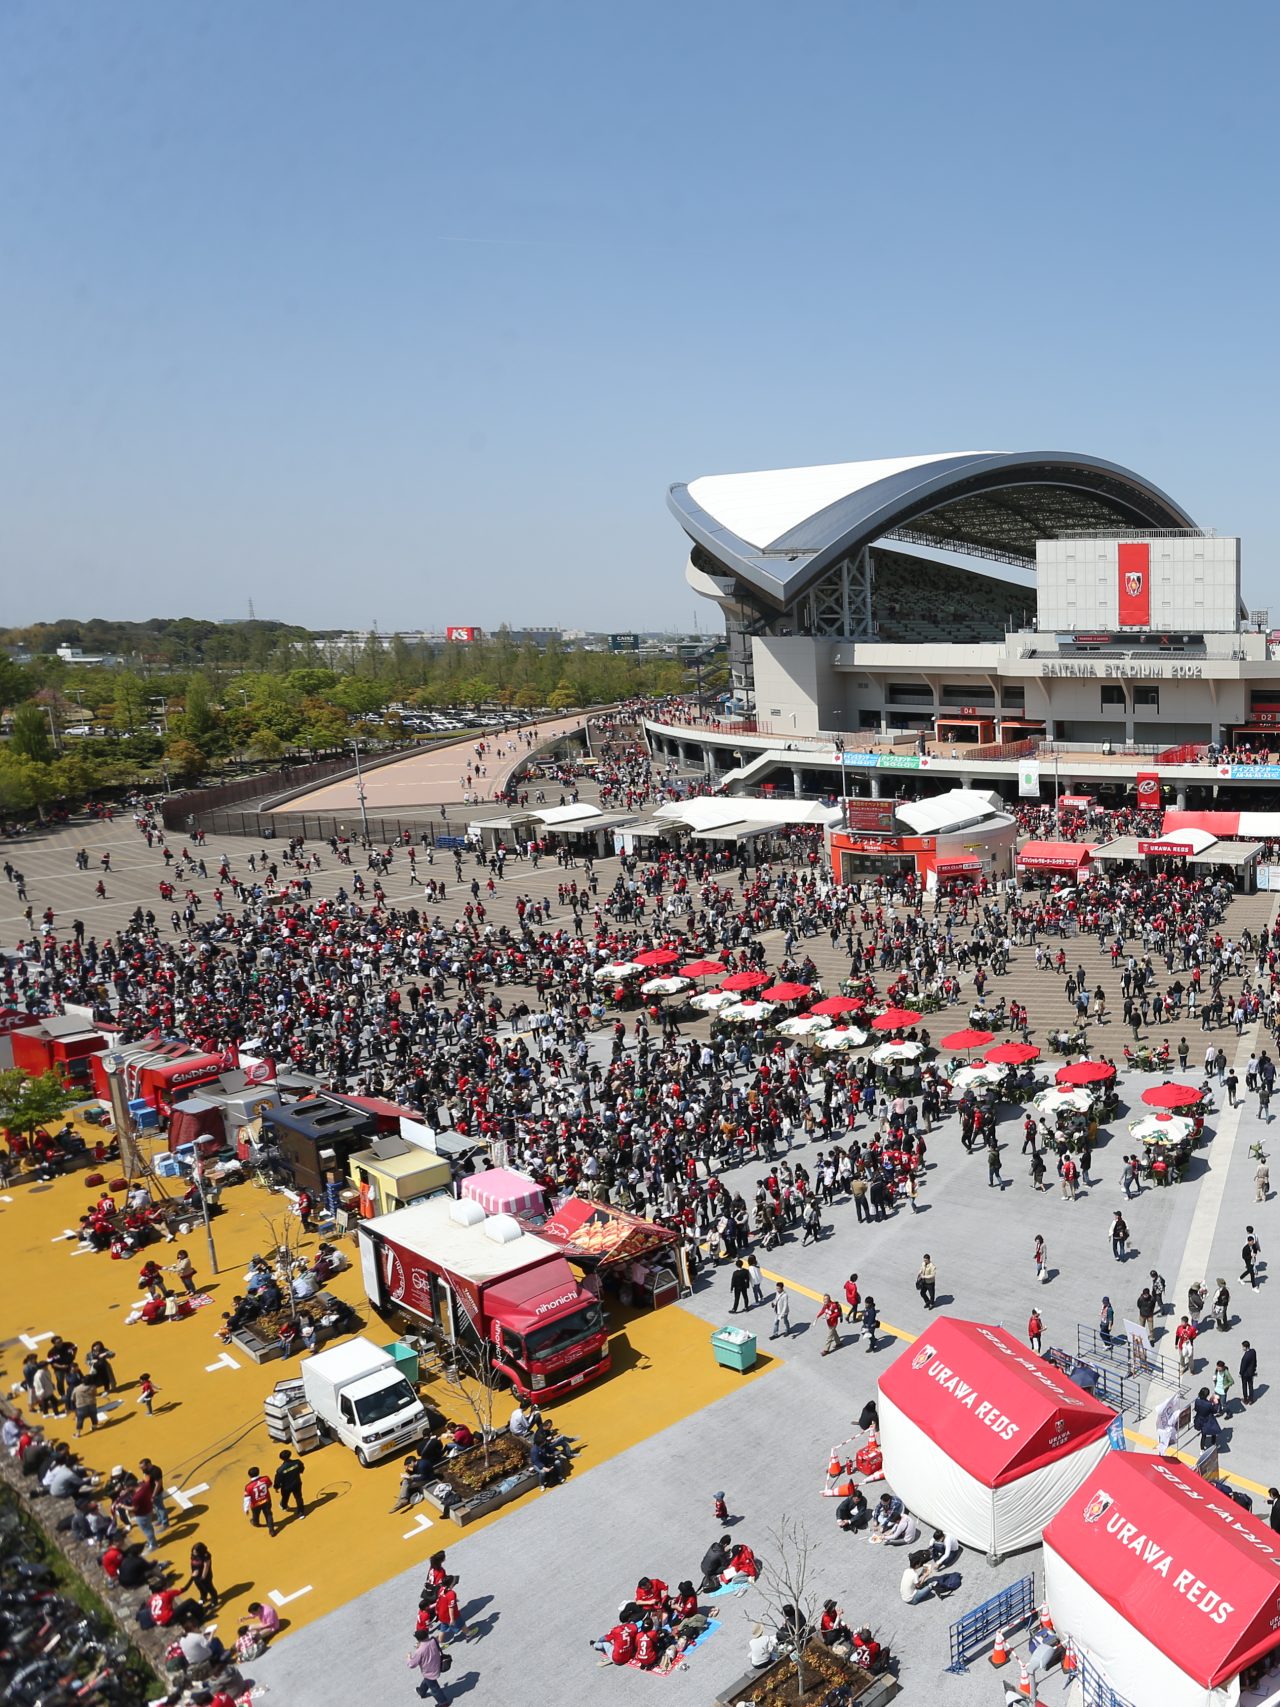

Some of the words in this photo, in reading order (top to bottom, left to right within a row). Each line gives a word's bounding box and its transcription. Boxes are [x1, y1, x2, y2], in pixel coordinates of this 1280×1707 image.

[1042, 663, 1097, 675] SAITAMA
[1104, 663, 1162, 676] STADIUM
[1171, 664, 1202, 676] 2002
[850, 836, 898, 846] チケットブース
[172, 1065, 217, 1083] GINDACO
[102, 1201, 113, 1211] 10
[535, 1290, 578, 1315] nihonichi
[976, 1327, 1016, 1356] REDS
[1014, 1357, 1065, 1395] URAWA
[928, 1360, 978, 1409] URAWA
[975, 1401, 1020, 1441] REDS
[1048, 1430, 1071, 1445] URAWA
[1051, 1437, 1068, 1448] REDS
[1151, 1463, 1204, 1500] REDS
[253, 1483, 267, 1500] 13
[1205, 1503, 1275, 1554] URAWA
[1106, 1512, 1174, 1578] URAWA
[1172, 1569, 1235, 1624] REDS
[151, 1599, 162, 1616] 12
[622, 1633, 630, 1649] 5
[640, 1640, 647, 1656] 3
[857, 1649, 870, 1662] 26
